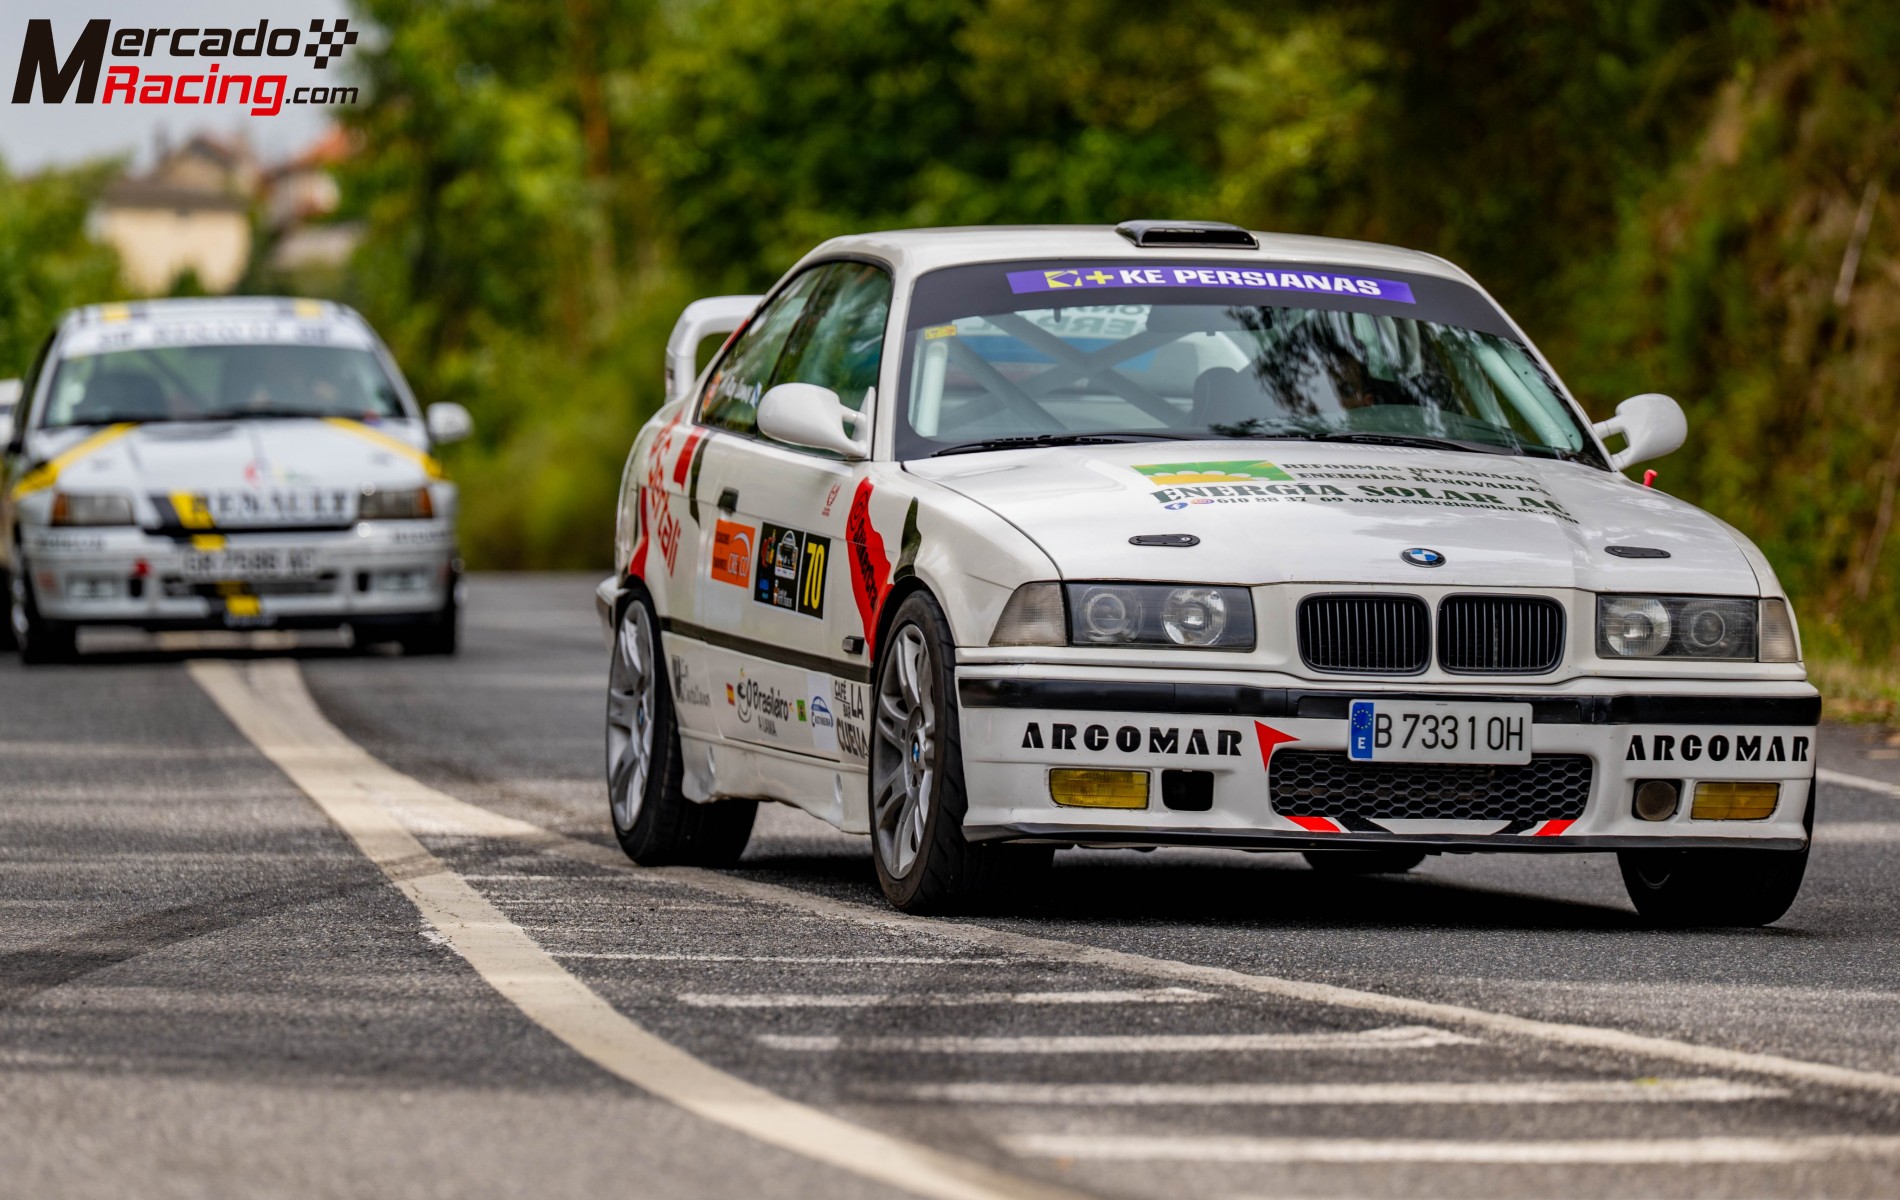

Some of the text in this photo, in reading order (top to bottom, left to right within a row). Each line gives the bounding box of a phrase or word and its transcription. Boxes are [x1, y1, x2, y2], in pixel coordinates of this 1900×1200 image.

[1119, 269, 1382, 296] KE PERSIANAS
[1282, 463, 1540, 485] REFORMAS INTEGRALES
[1412, 476, 1552, 496] RENOVABLES
[1150, 482, 1571, 516] ENERGÍA SOLAR AC
[803, 541, 825, 610] 70
[752, 681, 789, 722] Brasileiro
[834, 679, 847, 701] CAFÉ
[851, 683, 865, 721] LA
[1357, 737, 1366, 750] E
